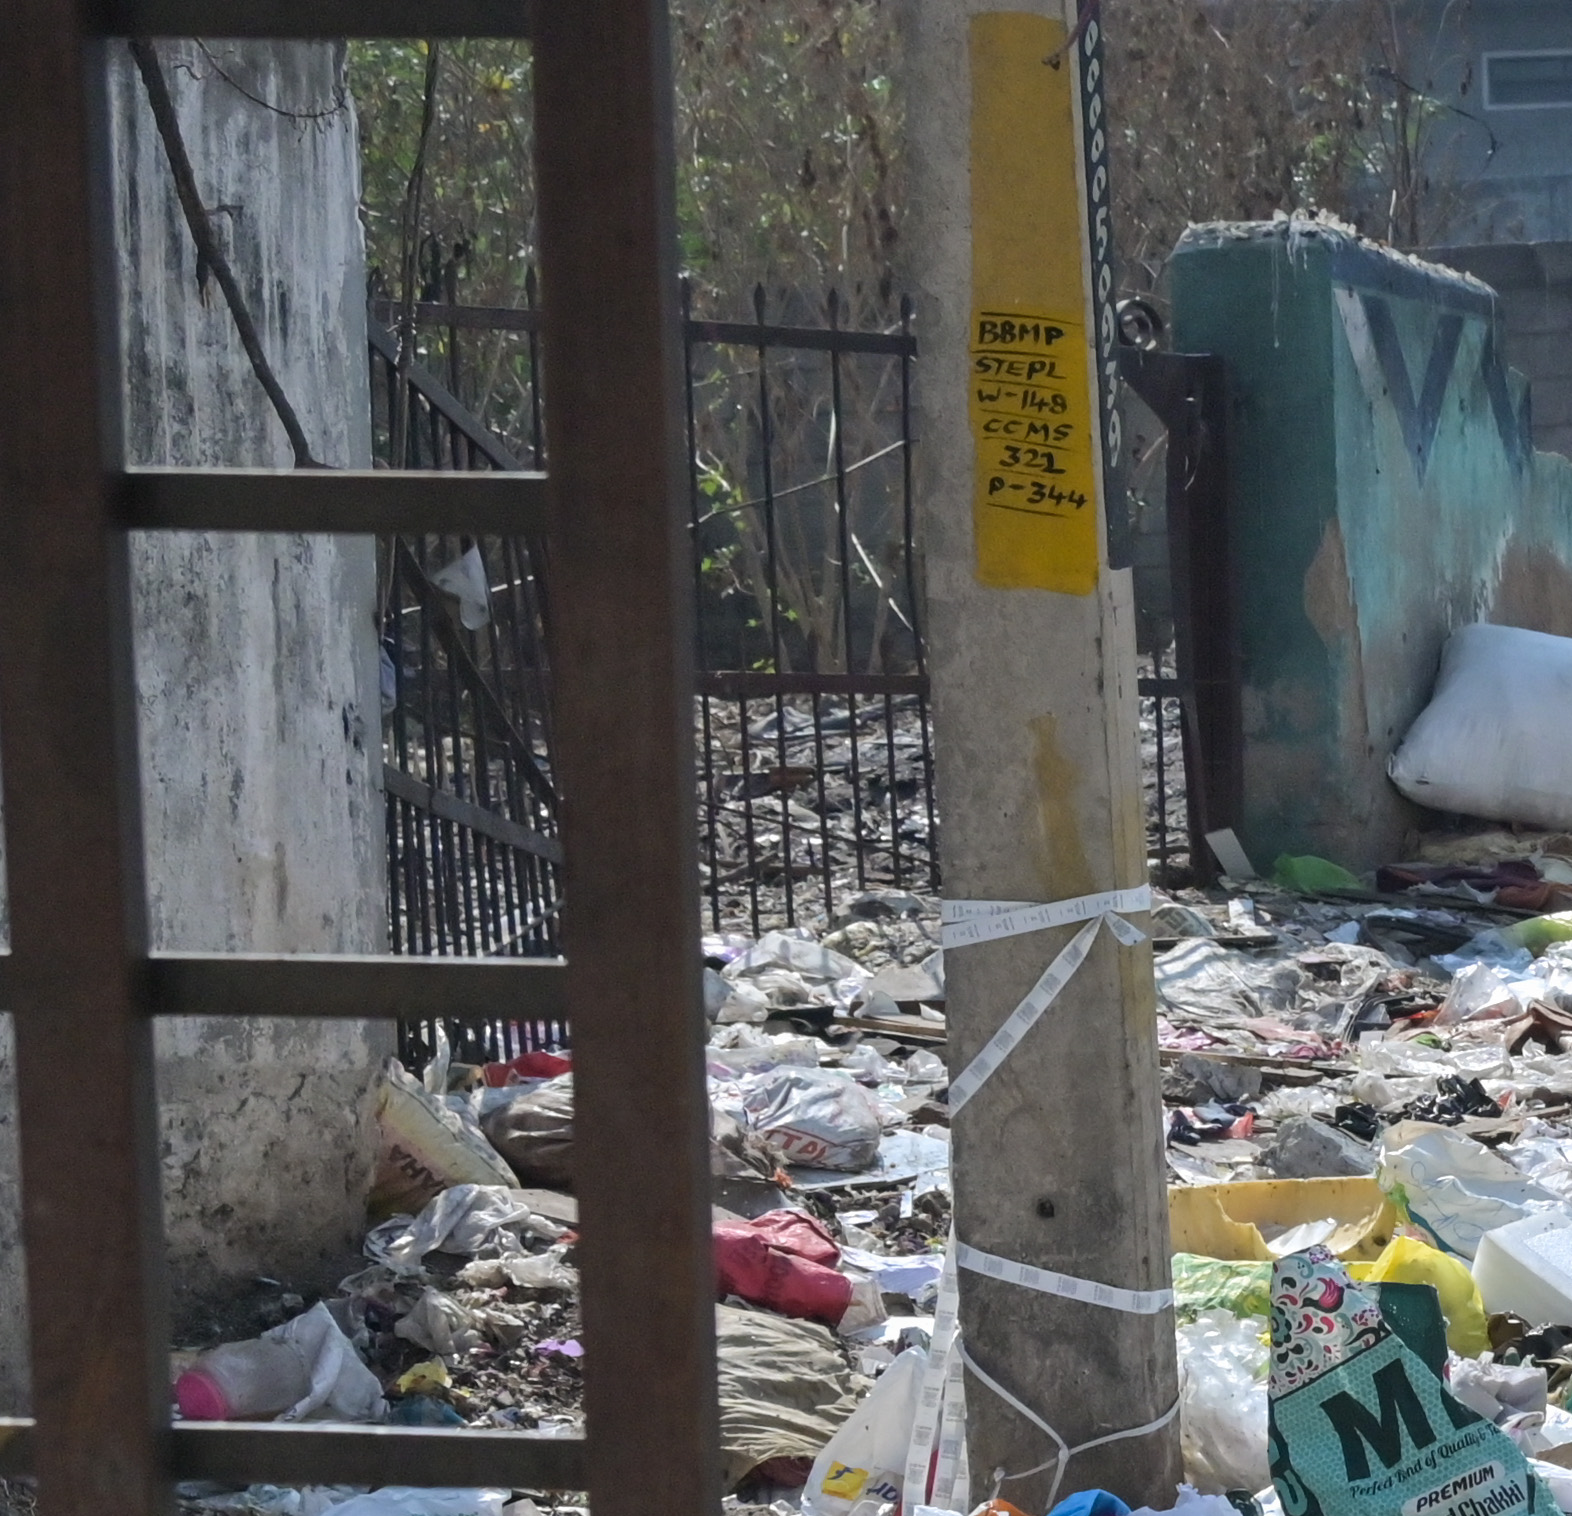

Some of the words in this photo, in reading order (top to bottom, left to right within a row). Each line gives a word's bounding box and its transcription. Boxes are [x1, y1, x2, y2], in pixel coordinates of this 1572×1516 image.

[978, 320, 1065, 345] BBMP
[974, 355, 1067, 380] STEPL
[977, 387, 1068, 414] W-148
[983, 418, 1074, 442] CCMS
[988, 476, 1088, 510] P-344
[1350, 1477, 1394, 1497] Perfect
[1425, 1451, 1438, 1470] of
[1415, 1465, 1495, 1513] PREMIUM
